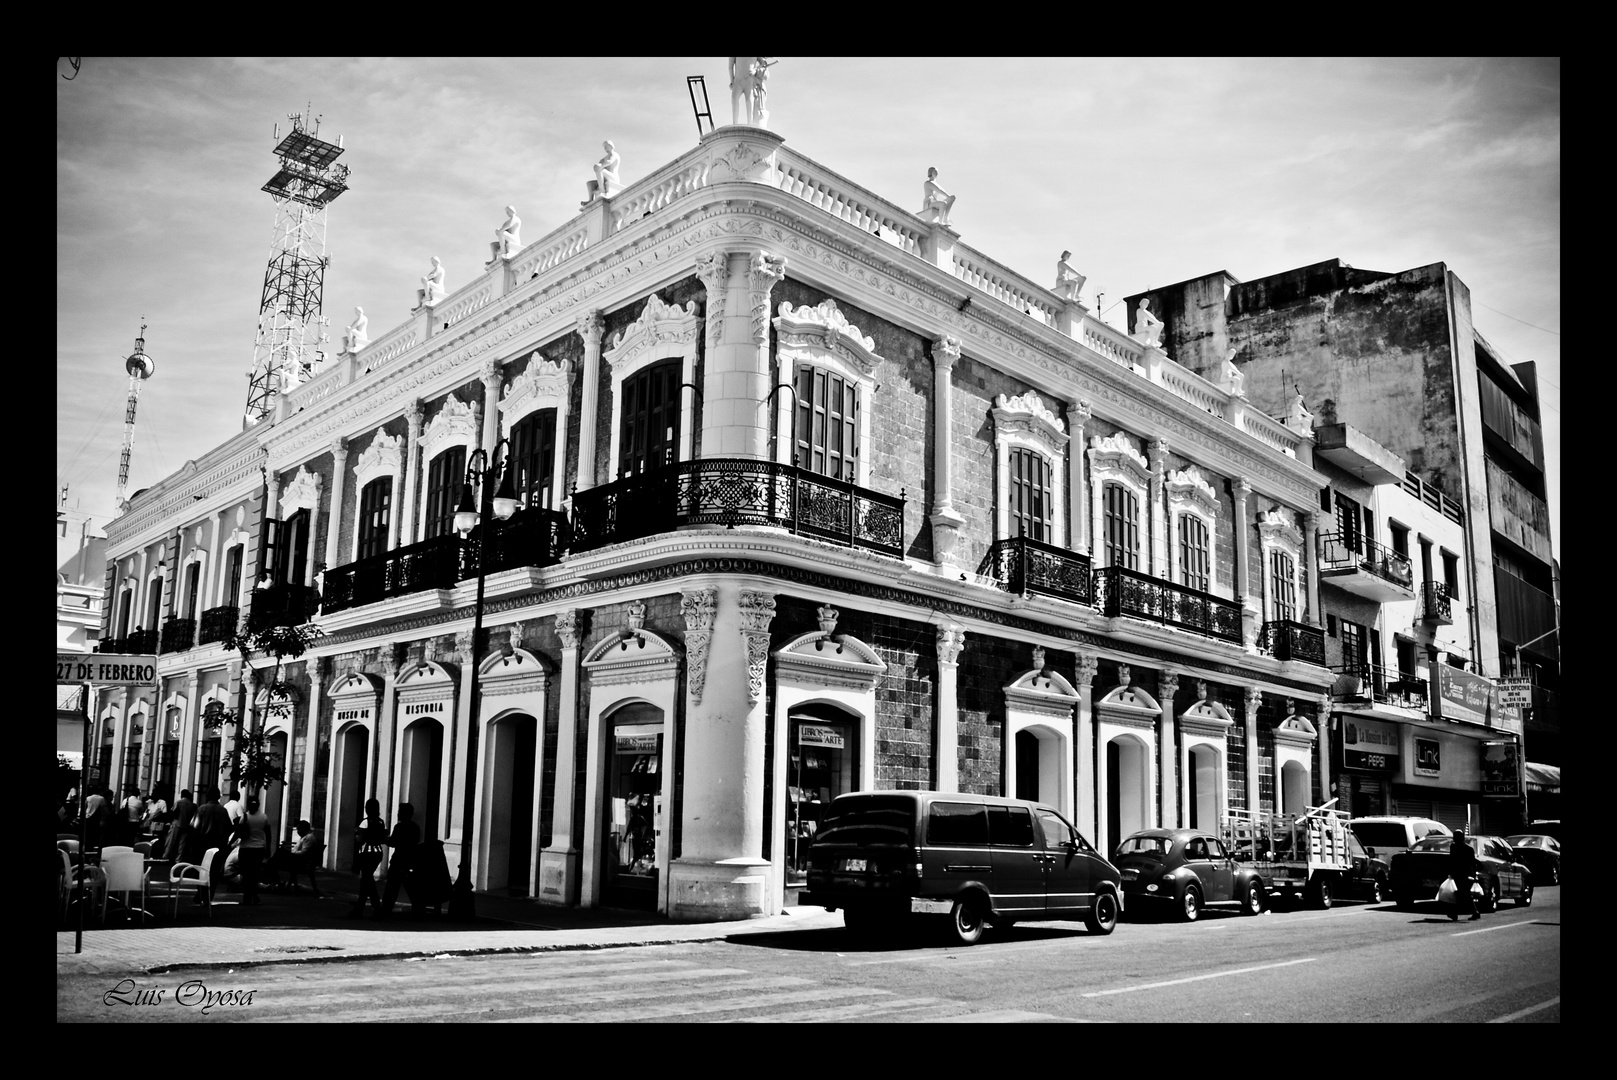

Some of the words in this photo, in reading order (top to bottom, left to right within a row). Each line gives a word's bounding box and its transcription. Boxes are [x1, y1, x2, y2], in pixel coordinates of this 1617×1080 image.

[57, 663, 72, 680] 27
[77, 663, 94, 680] DE
[99, 664, 154, 681] FEBRERO
[337, 710, 358, 720] MUSEO
[361, 709, 369, 718] DE
[406, 702, 443, 715] HISTORIA
[801, 727, 823, 738] LIBROS
[617, 737, 637, 746] LIBROS
[1367, 754, 1386, 768] PEPSI
[1418, 745, 1438, 765] Link
